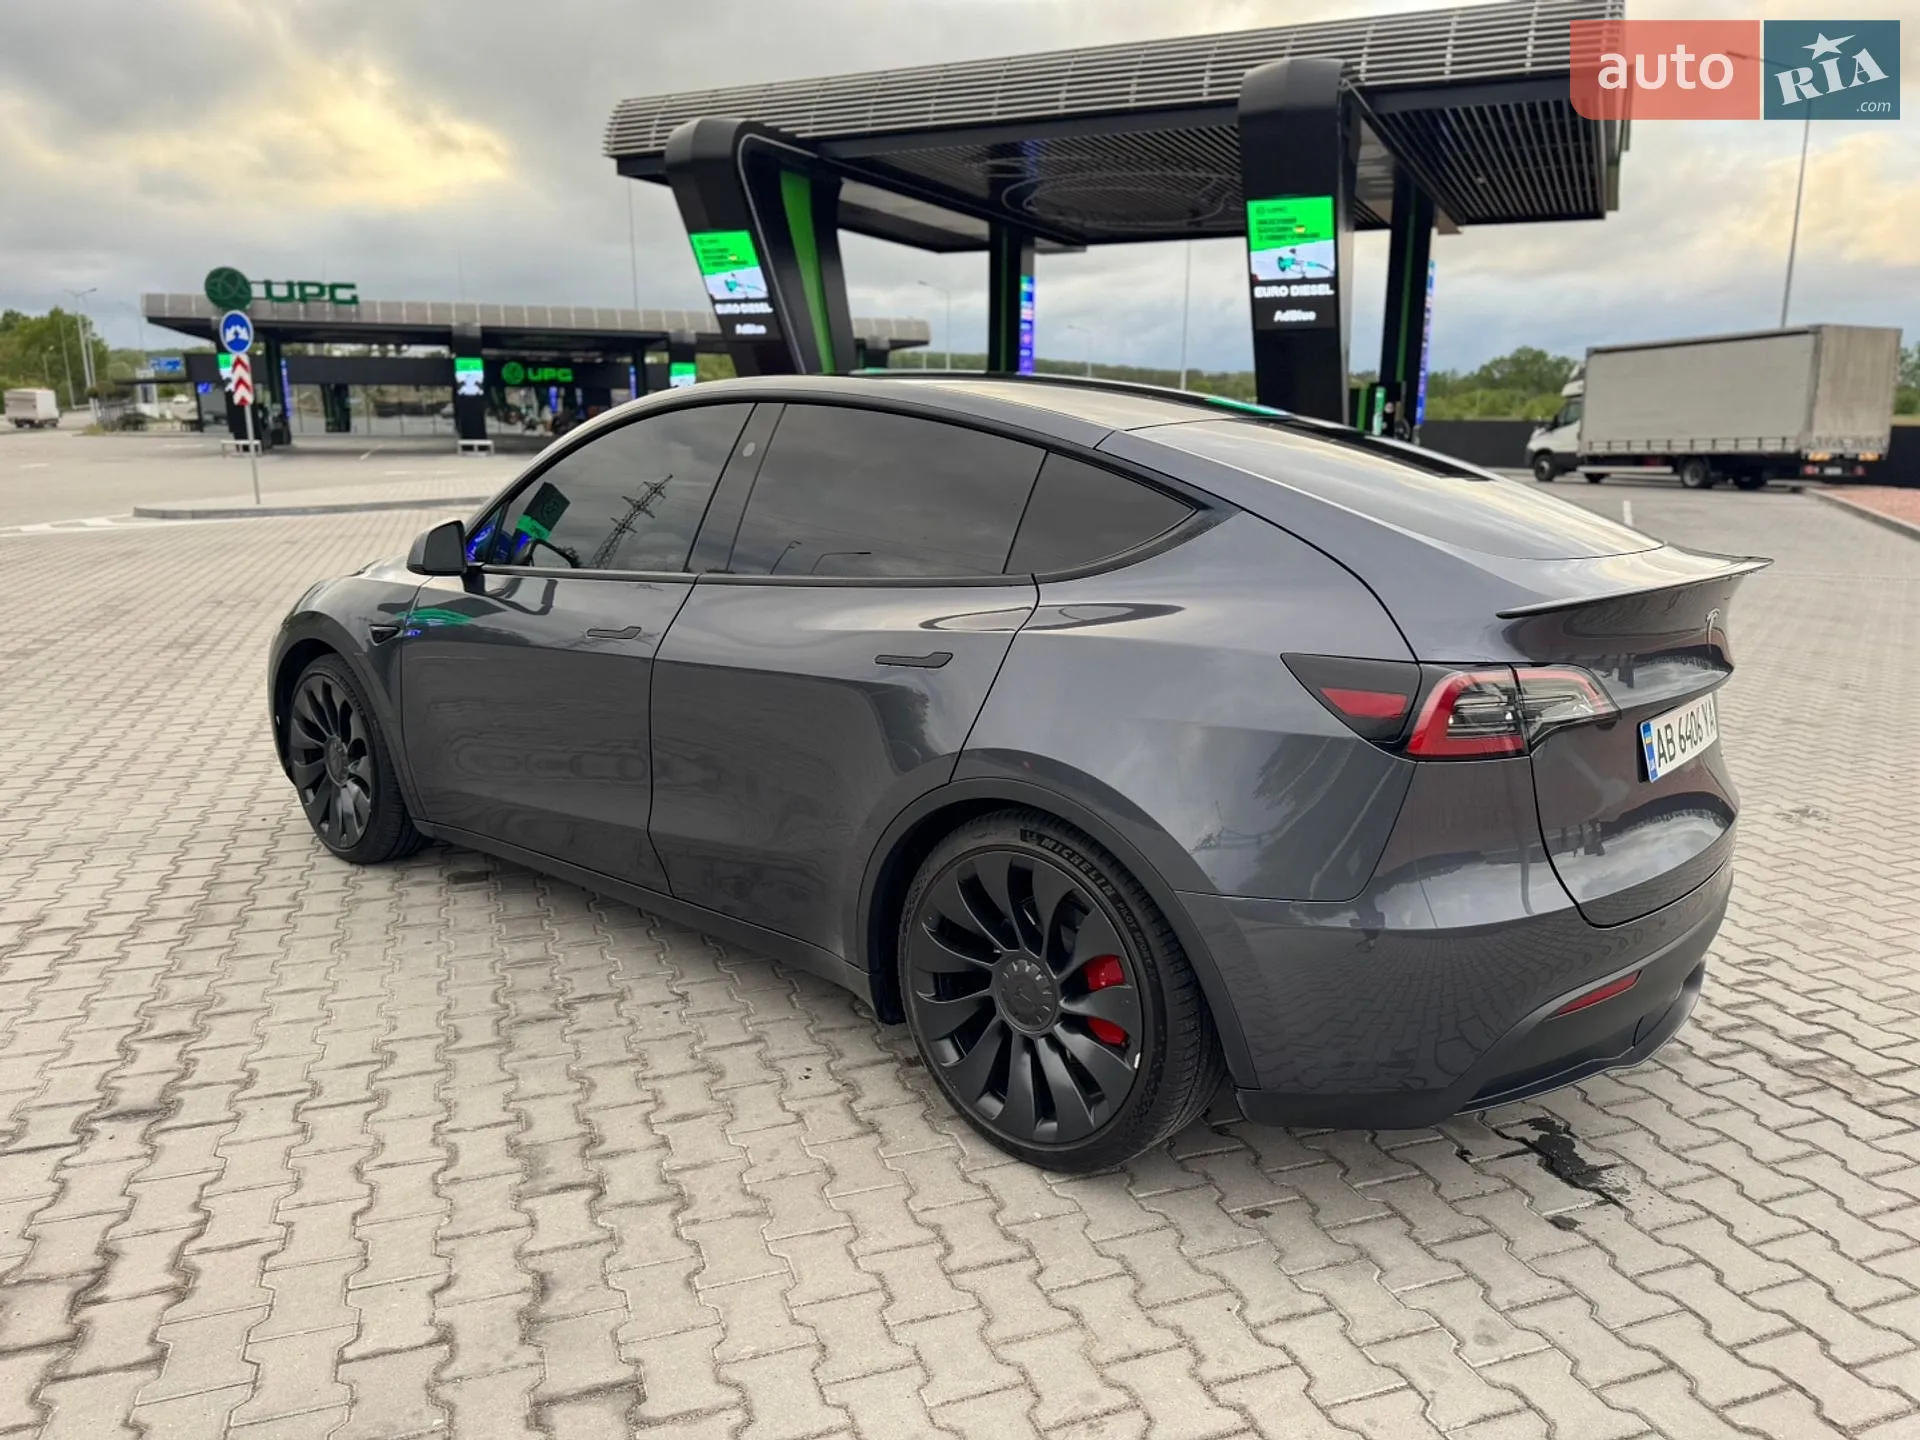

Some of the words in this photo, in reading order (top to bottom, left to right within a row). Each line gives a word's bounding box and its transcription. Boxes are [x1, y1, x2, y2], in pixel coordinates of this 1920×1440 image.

[264, 279, 359, 304] UPG
[527, 367, 573, 382] UPG
[1656, 723, 1676, 767] AB
[1040, 837, 1115, 897] MICHELIN
[1116, 902, 1138, 929] PILOT
